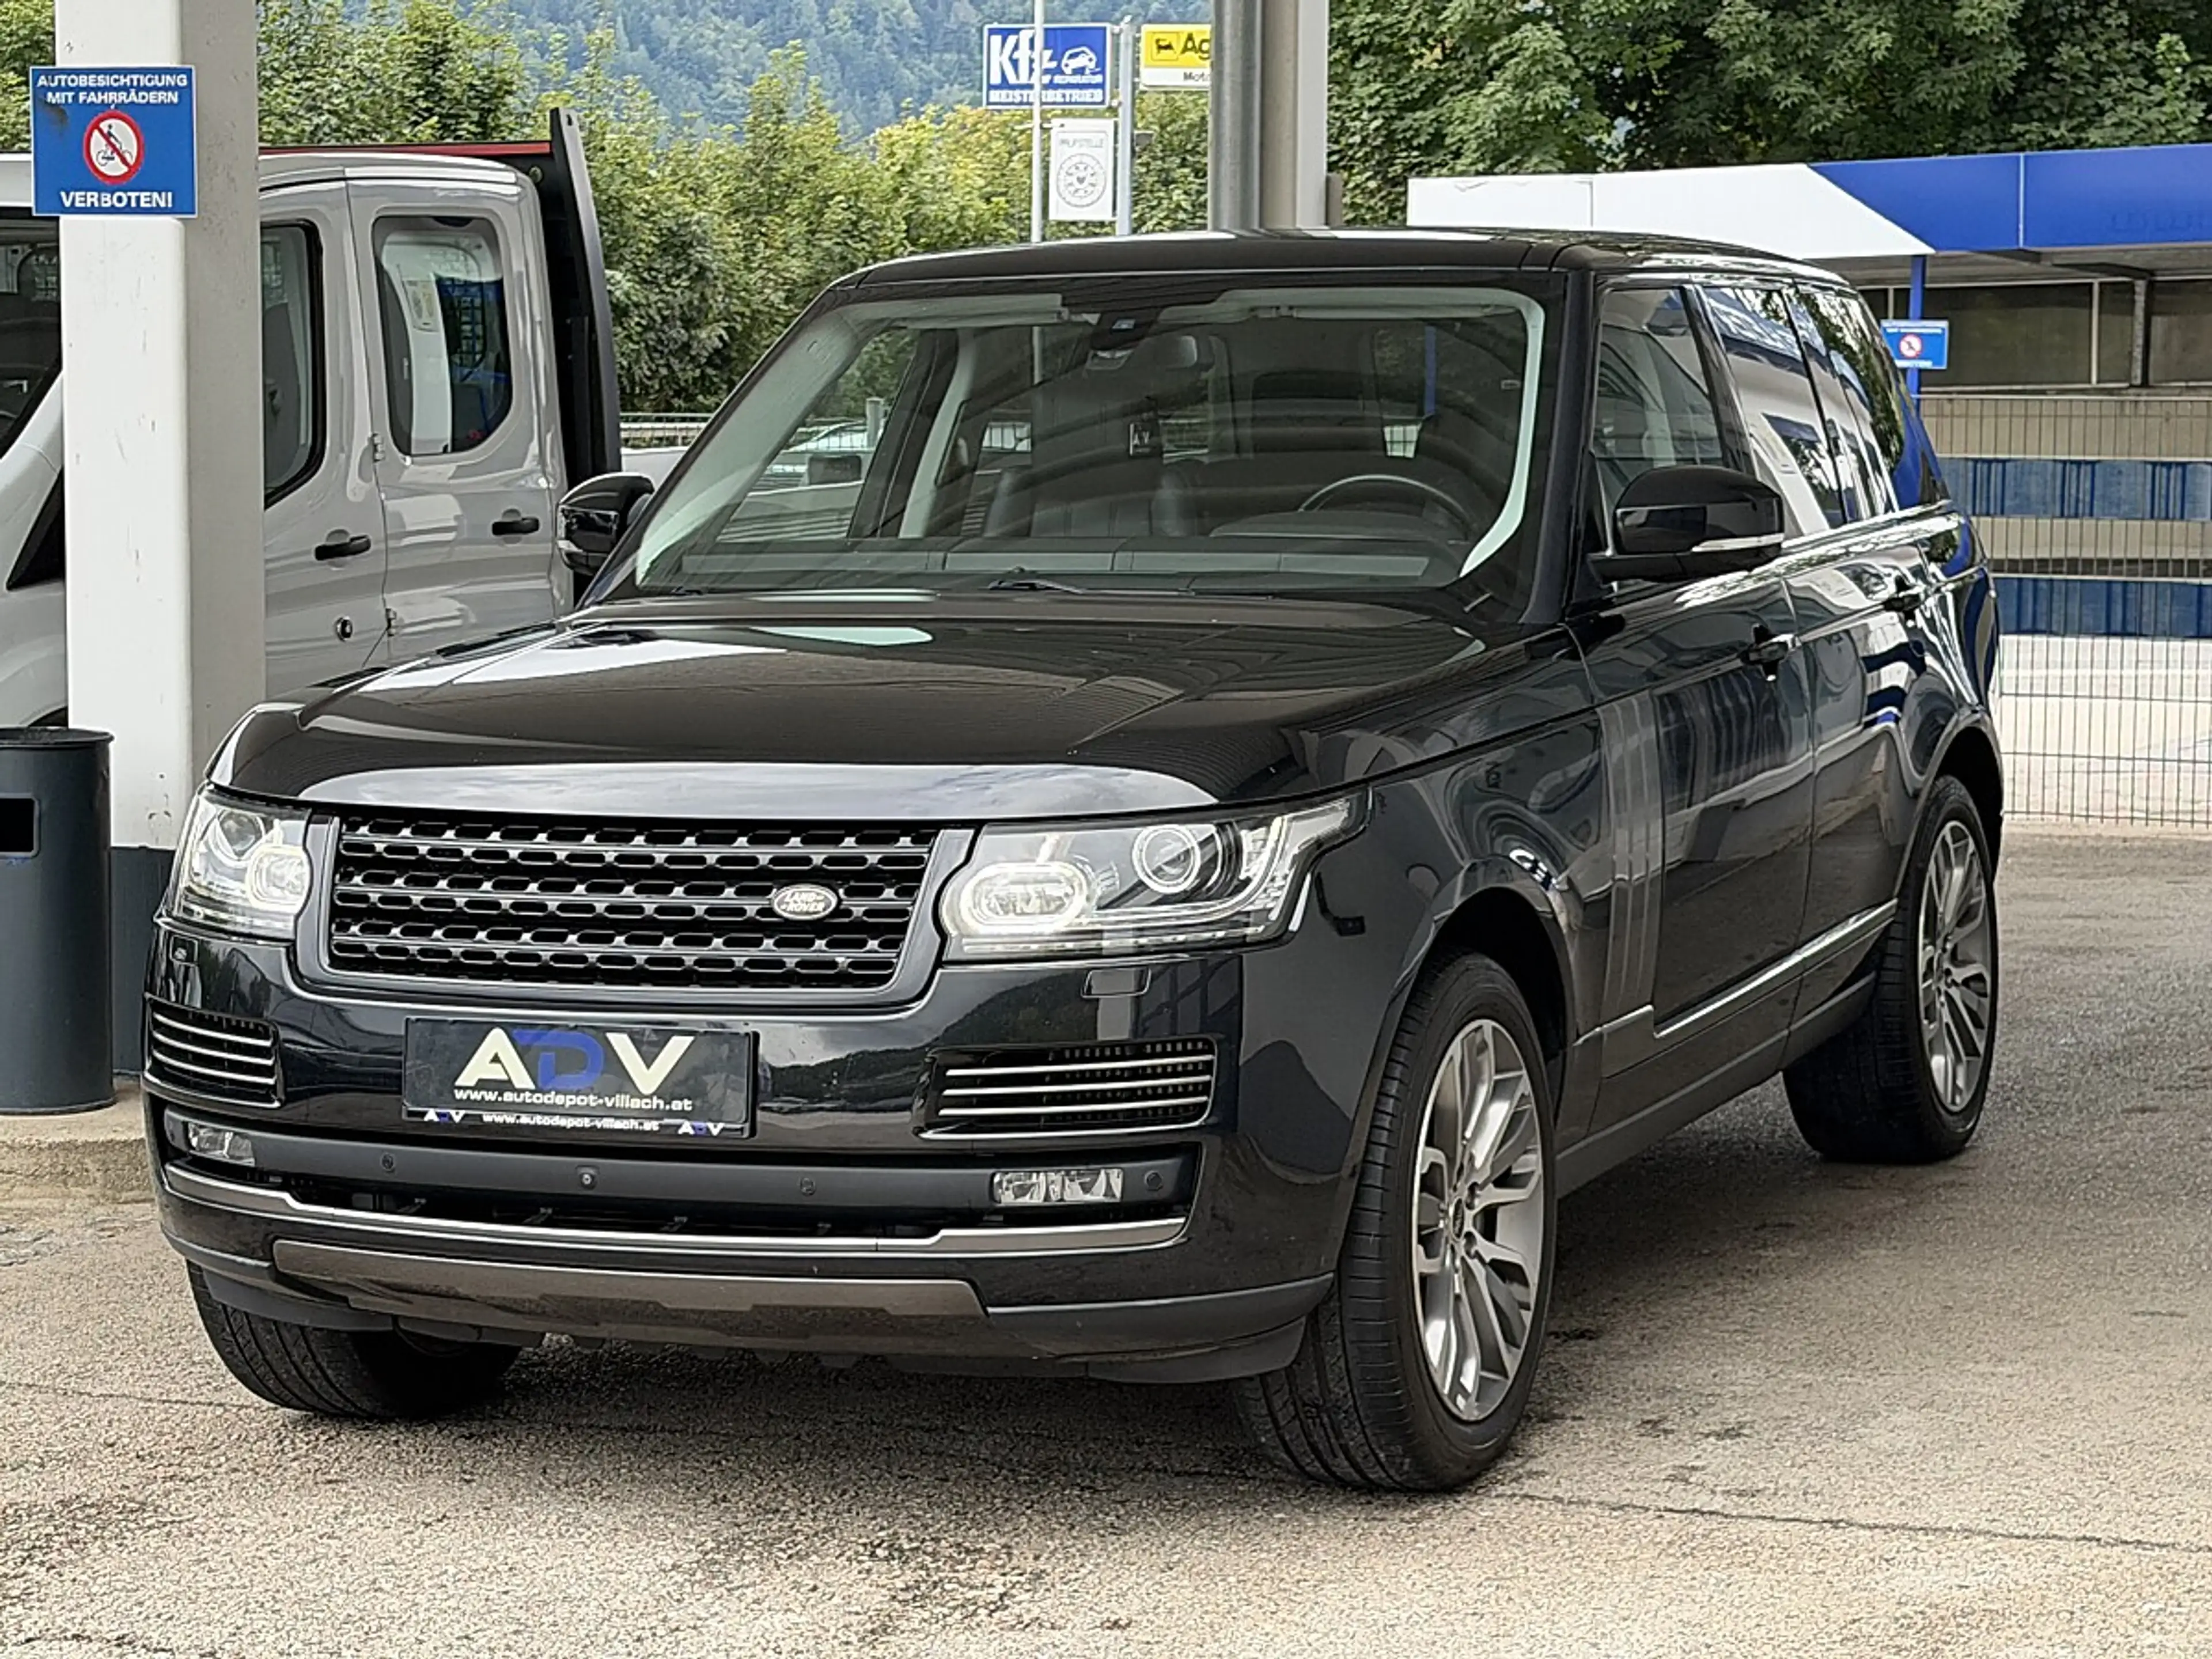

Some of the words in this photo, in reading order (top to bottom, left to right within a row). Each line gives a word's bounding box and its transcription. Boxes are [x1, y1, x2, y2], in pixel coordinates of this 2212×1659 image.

[37, 74, 188, 87] AUTOBESICHTIGUNG
[46, 91, 75, 104] MIT
[78, 89, 179, 104] FAHRRÄDERN
[60, 191, 173, 207] VERBOTEN!
[454, 1027, 695, 1095] ADV
[454, 1089, 693, 1111] www.autodepot-villach.at
[482, 1113, 660, 1131] www.autodepot-villach.at
